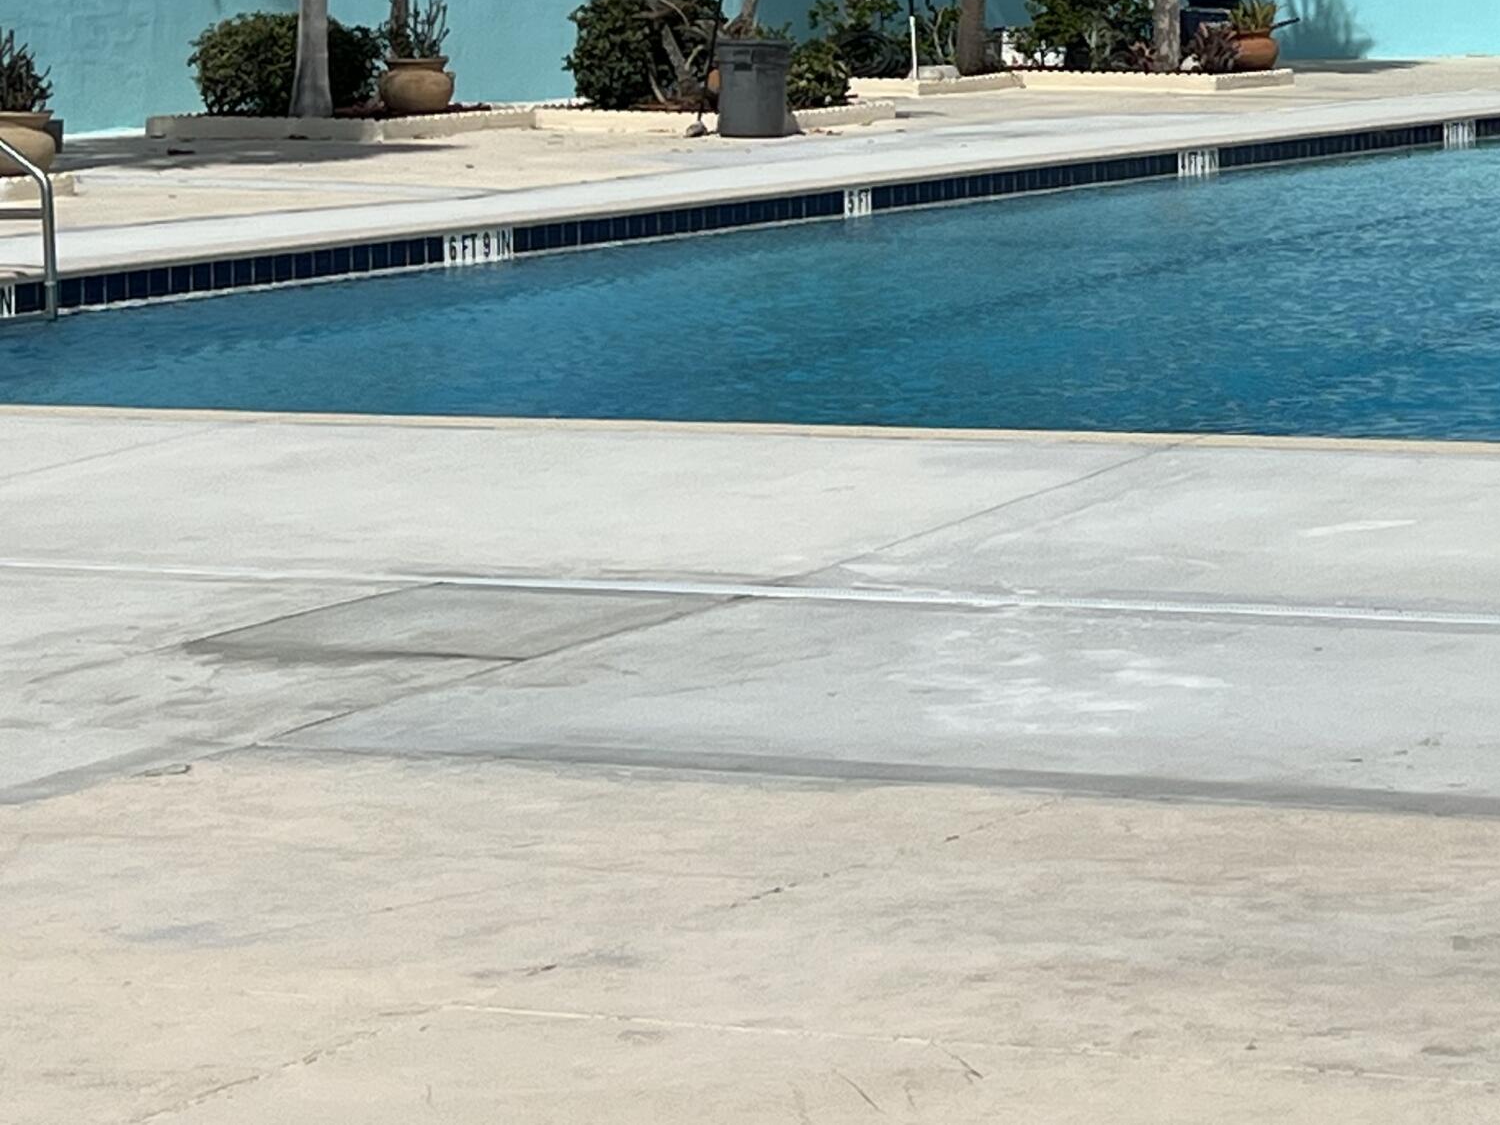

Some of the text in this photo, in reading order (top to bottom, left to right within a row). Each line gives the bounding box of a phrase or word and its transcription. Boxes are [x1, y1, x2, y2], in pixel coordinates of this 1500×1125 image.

[858, 188, 870, 213] FT
[449, 228, 512, 261] 6 FT 9 IN
